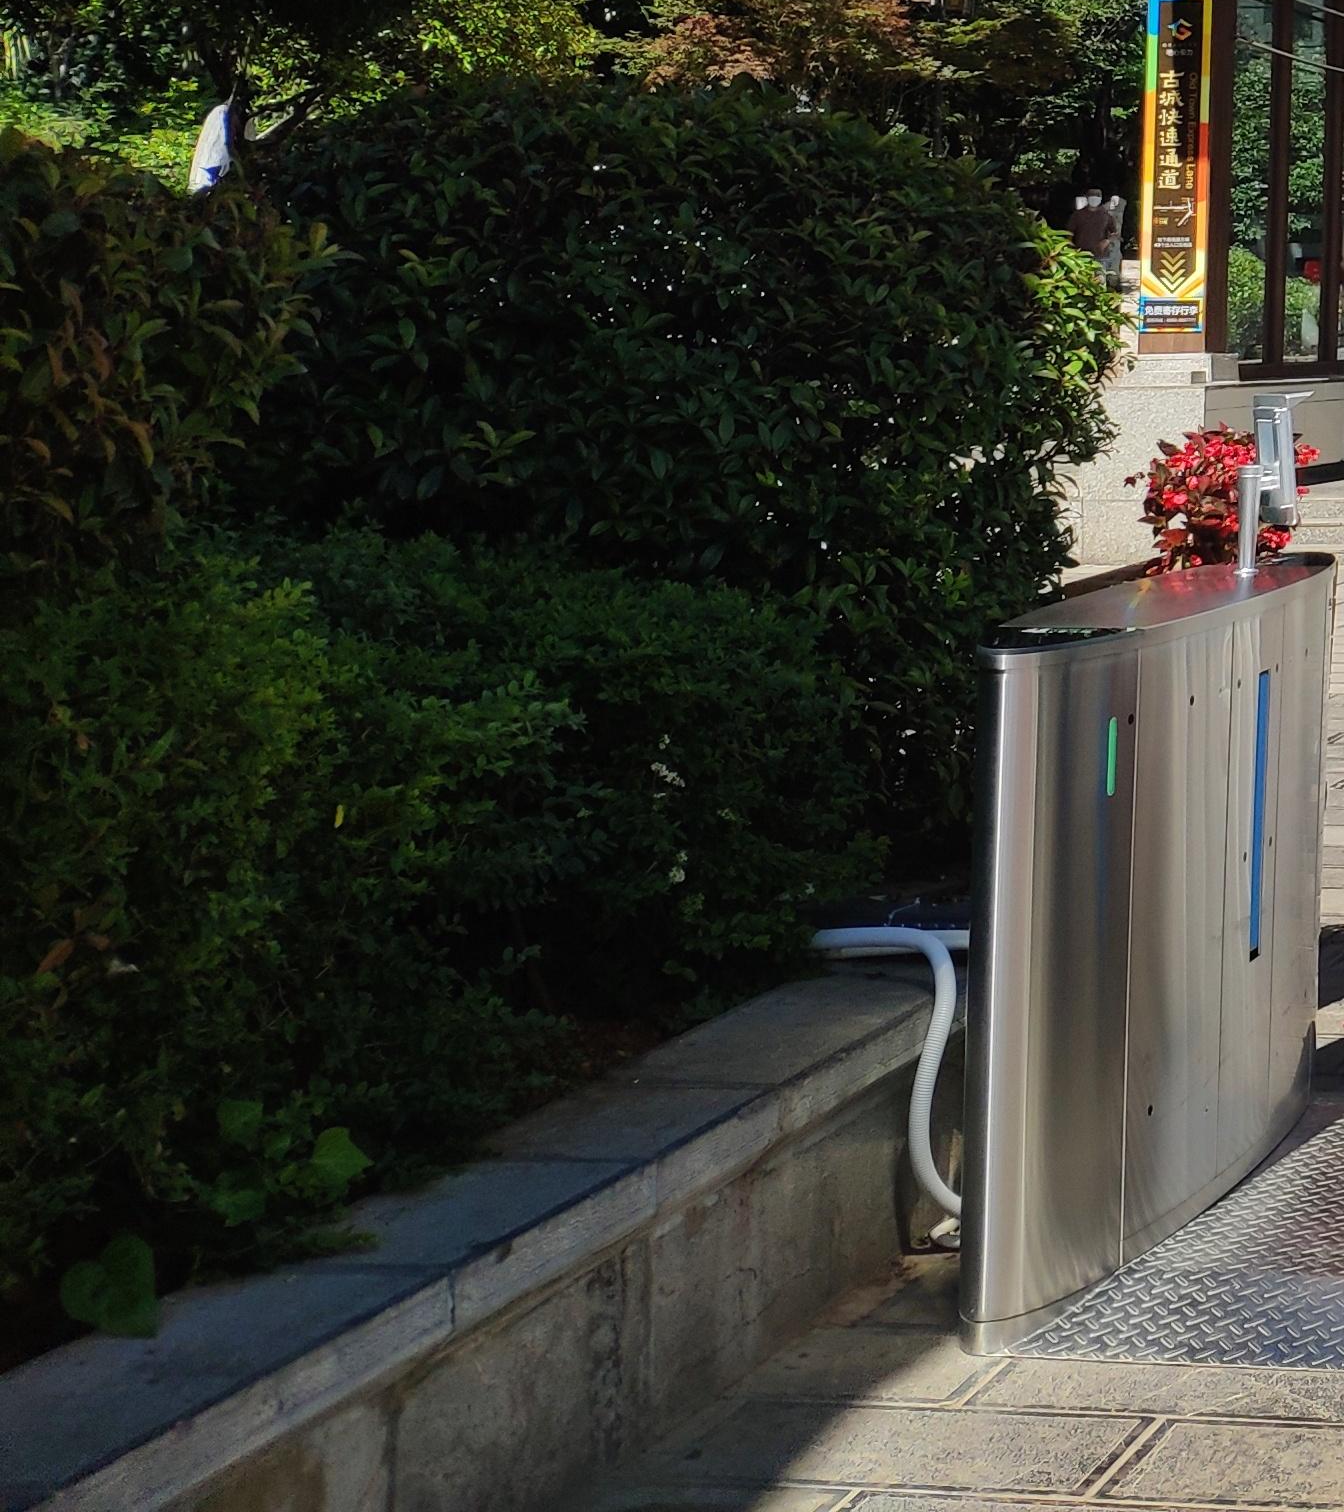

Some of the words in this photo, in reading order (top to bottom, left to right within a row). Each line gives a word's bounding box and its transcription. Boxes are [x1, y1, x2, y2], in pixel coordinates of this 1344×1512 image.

[1157, 69, 1185, 190] 古城快速通道
